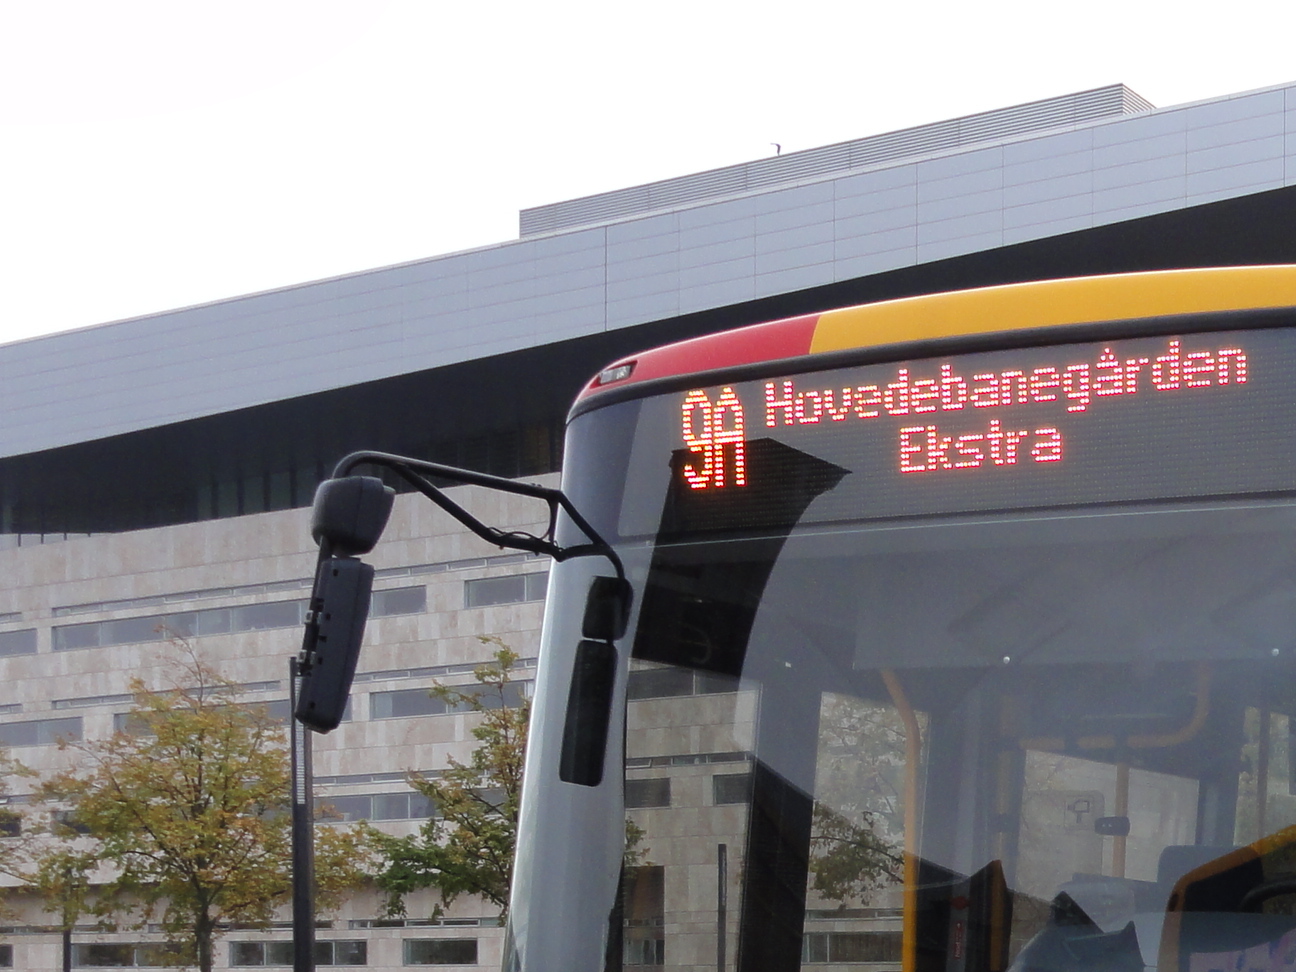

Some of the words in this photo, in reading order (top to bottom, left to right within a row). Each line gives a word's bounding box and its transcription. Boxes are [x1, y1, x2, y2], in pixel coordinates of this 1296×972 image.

[682, 386, 747, 489] 9A
[764, 340, 1248, 428] Hovedebanegården
[899, 420, 1063, 473] Ekstra
